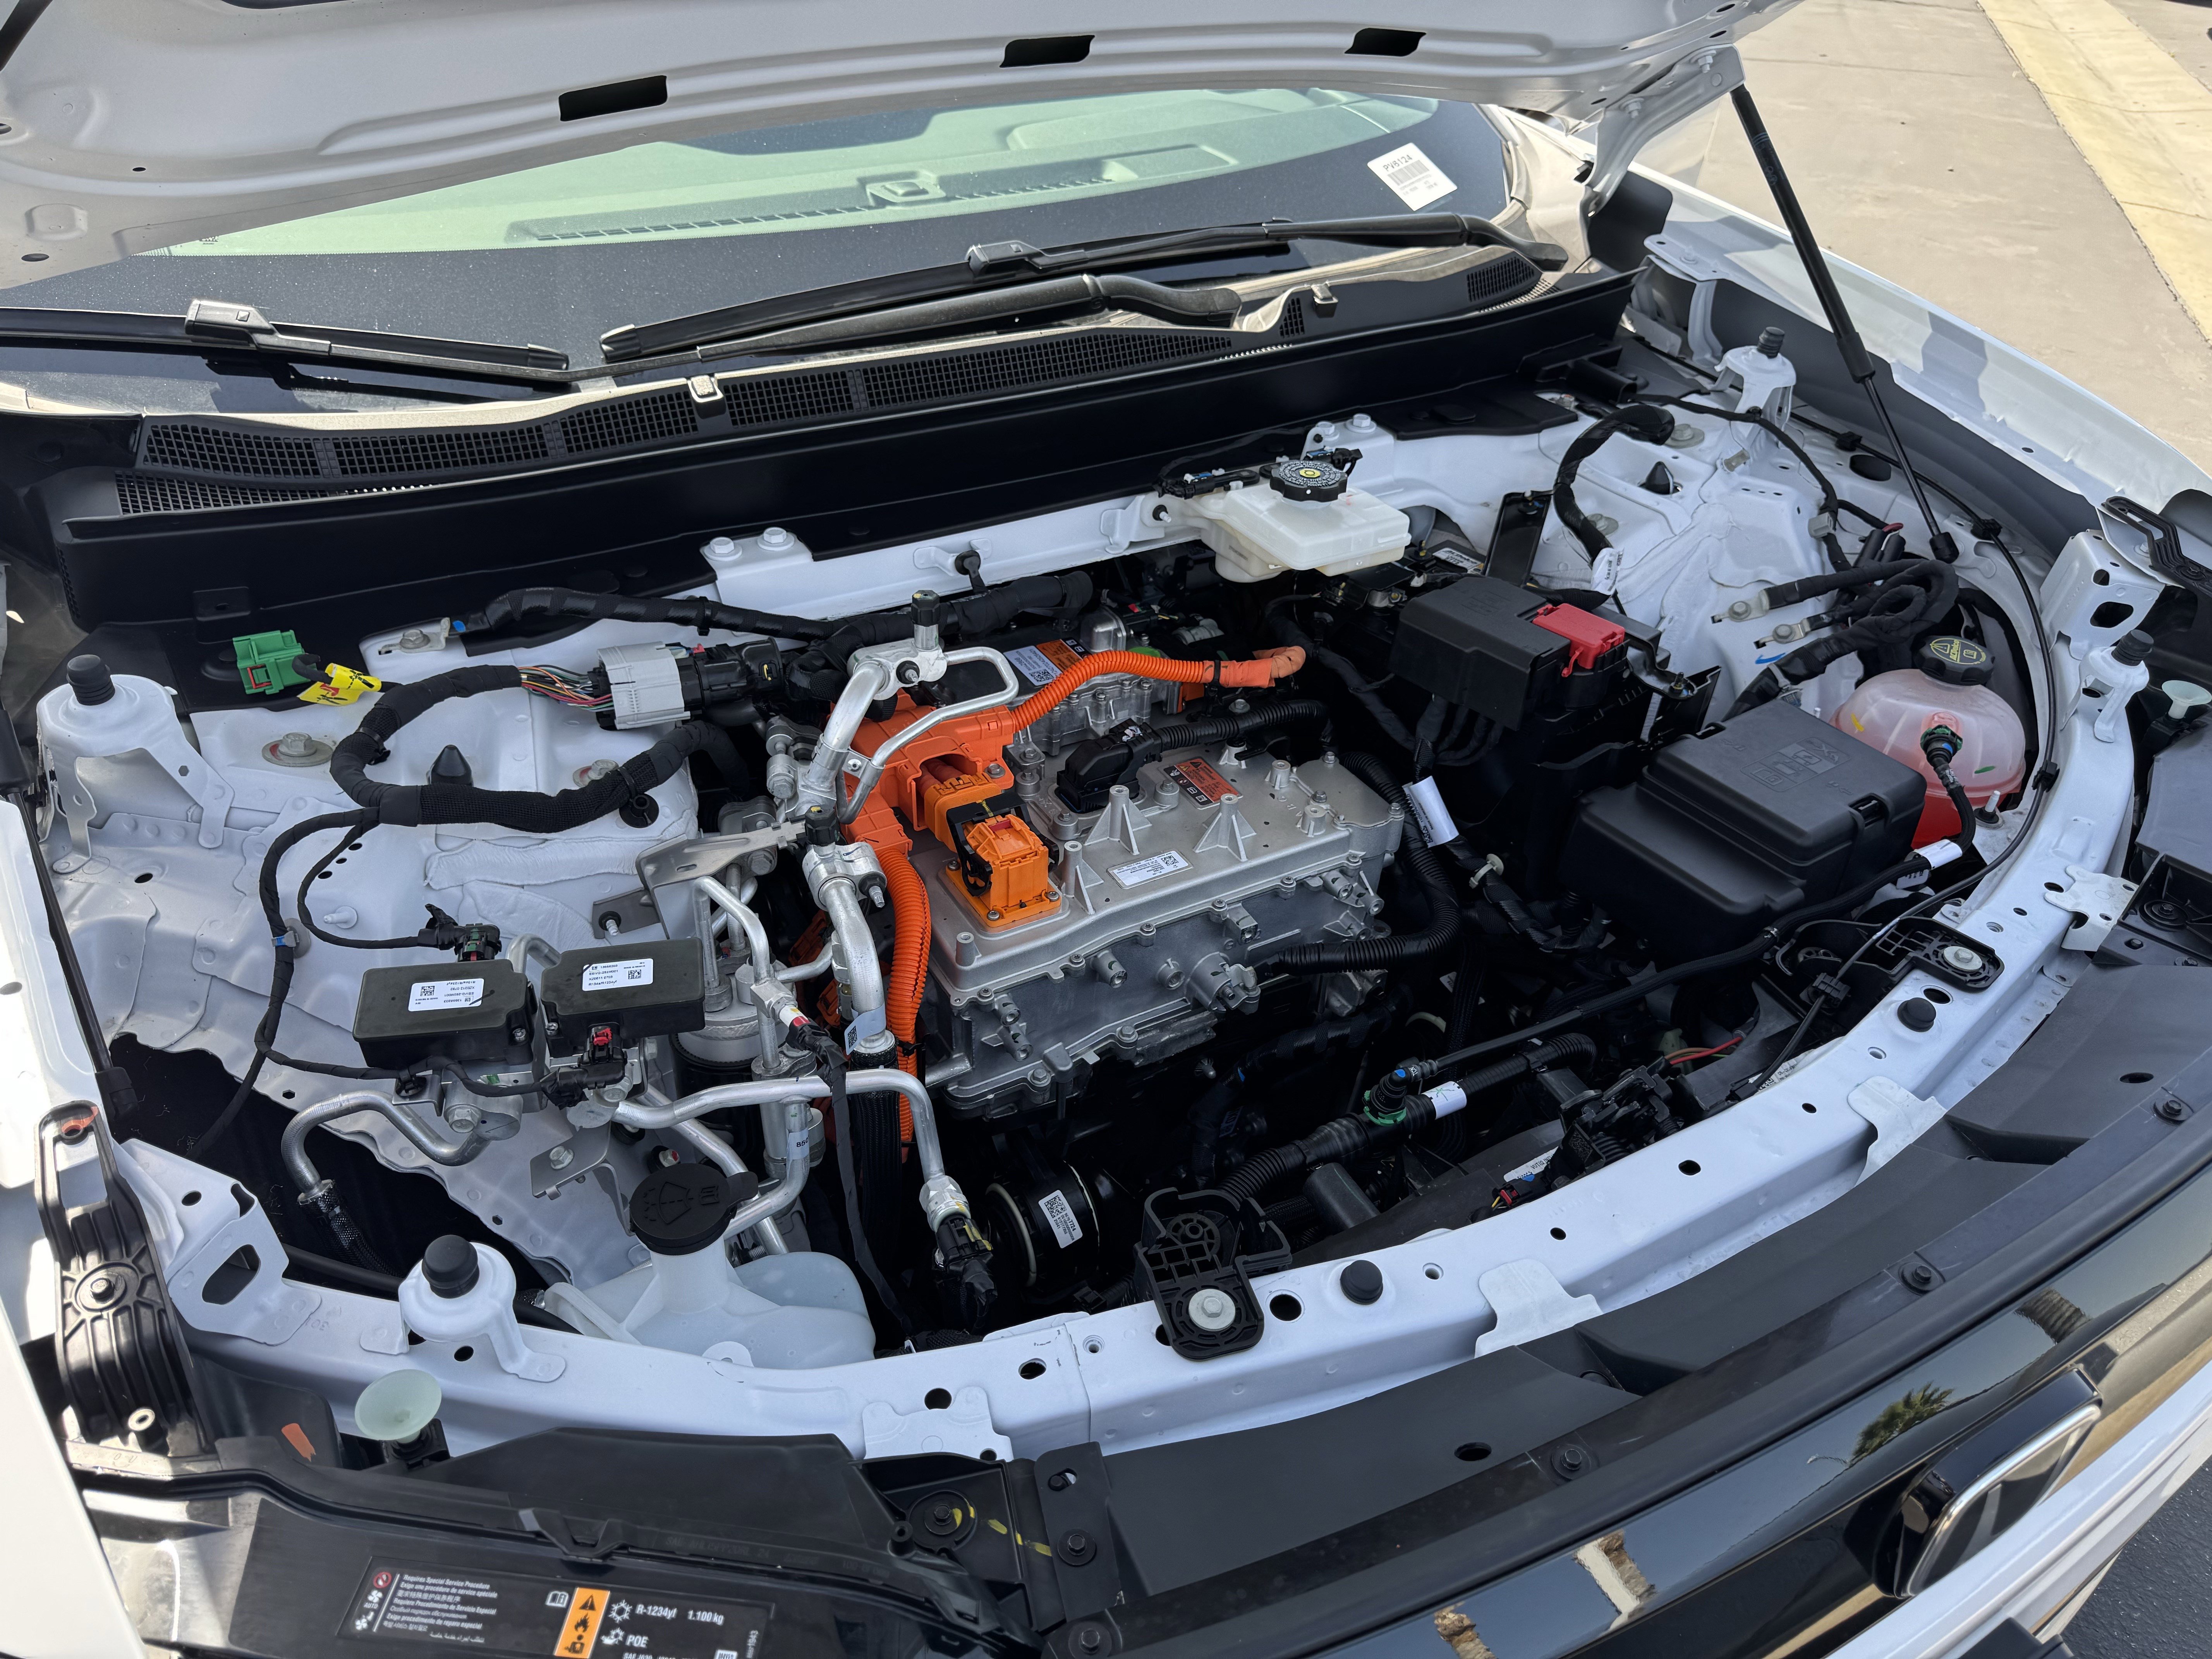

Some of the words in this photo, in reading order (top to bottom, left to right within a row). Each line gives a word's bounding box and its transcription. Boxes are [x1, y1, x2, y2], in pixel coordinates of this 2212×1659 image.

[1949, 639, 1960, 661] ACDelco
[425, 1585, 450, 1593] procédure
[416, 1601, 449, 1609] Procedimiento
[477, 1607, 496, 1615] Especial
[635, 1602, 678, 1620] R-1234yf
[687, 1609, 713, 1623] 1.100
[713, 1613, 725, 1626] kg
[402, 1614, 436, 1624] procedimento
[461, 1621, 482, 1630] especial
[626, 1634, 649, 1648] POE
